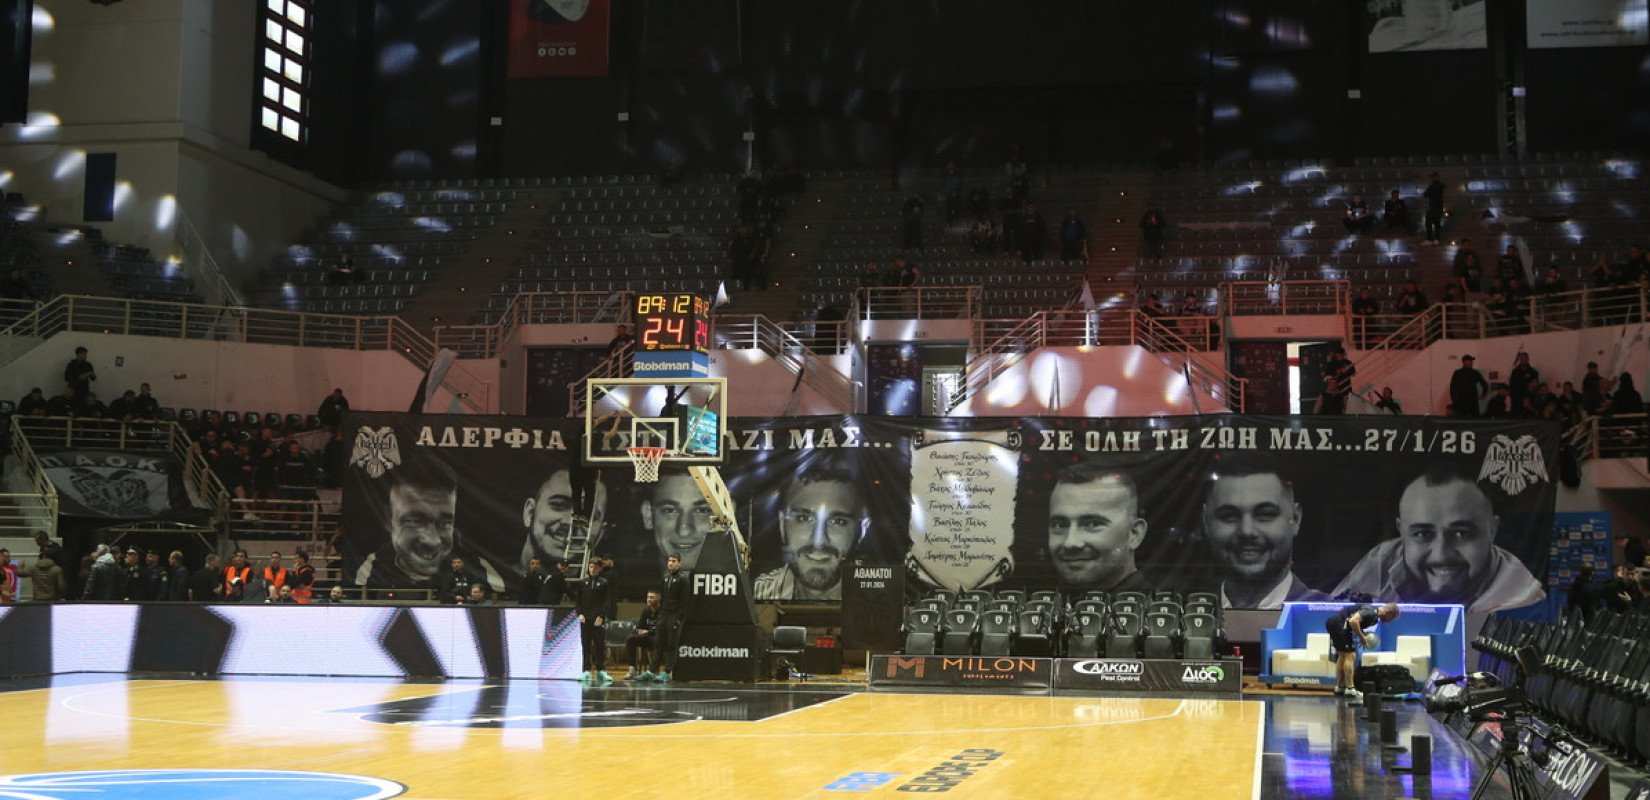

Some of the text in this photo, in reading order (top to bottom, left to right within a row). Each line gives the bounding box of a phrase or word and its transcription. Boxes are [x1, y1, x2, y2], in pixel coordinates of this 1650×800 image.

[637, 295, 691, 314] 89:12
[643, 318, 684, 345] 24
[633, 361, 690, 372] Stoiximan
[416, 425, 567, 450] ΑΔΕΡΦΙΑ
[788, 426, 893, 450] ΜΑΣ...
[1039, 430, 1073, 451] ΣΕ
[1085, 430, 1142, 452] ΟΛΗ
[1152, 429, 1189, 451] ΤΗ
[1200, 427, 1258, 450] ΖΩΗ
[854, 568, 892, 579] ΑΘΑΝΑΤΟΙ
[693, 573, 738, 596] FIBA
[678, 645, 749, 658] Stoiximan
[943, 657, 1036, 673] MILON
[1181, 666, 1218, 683] Διός
